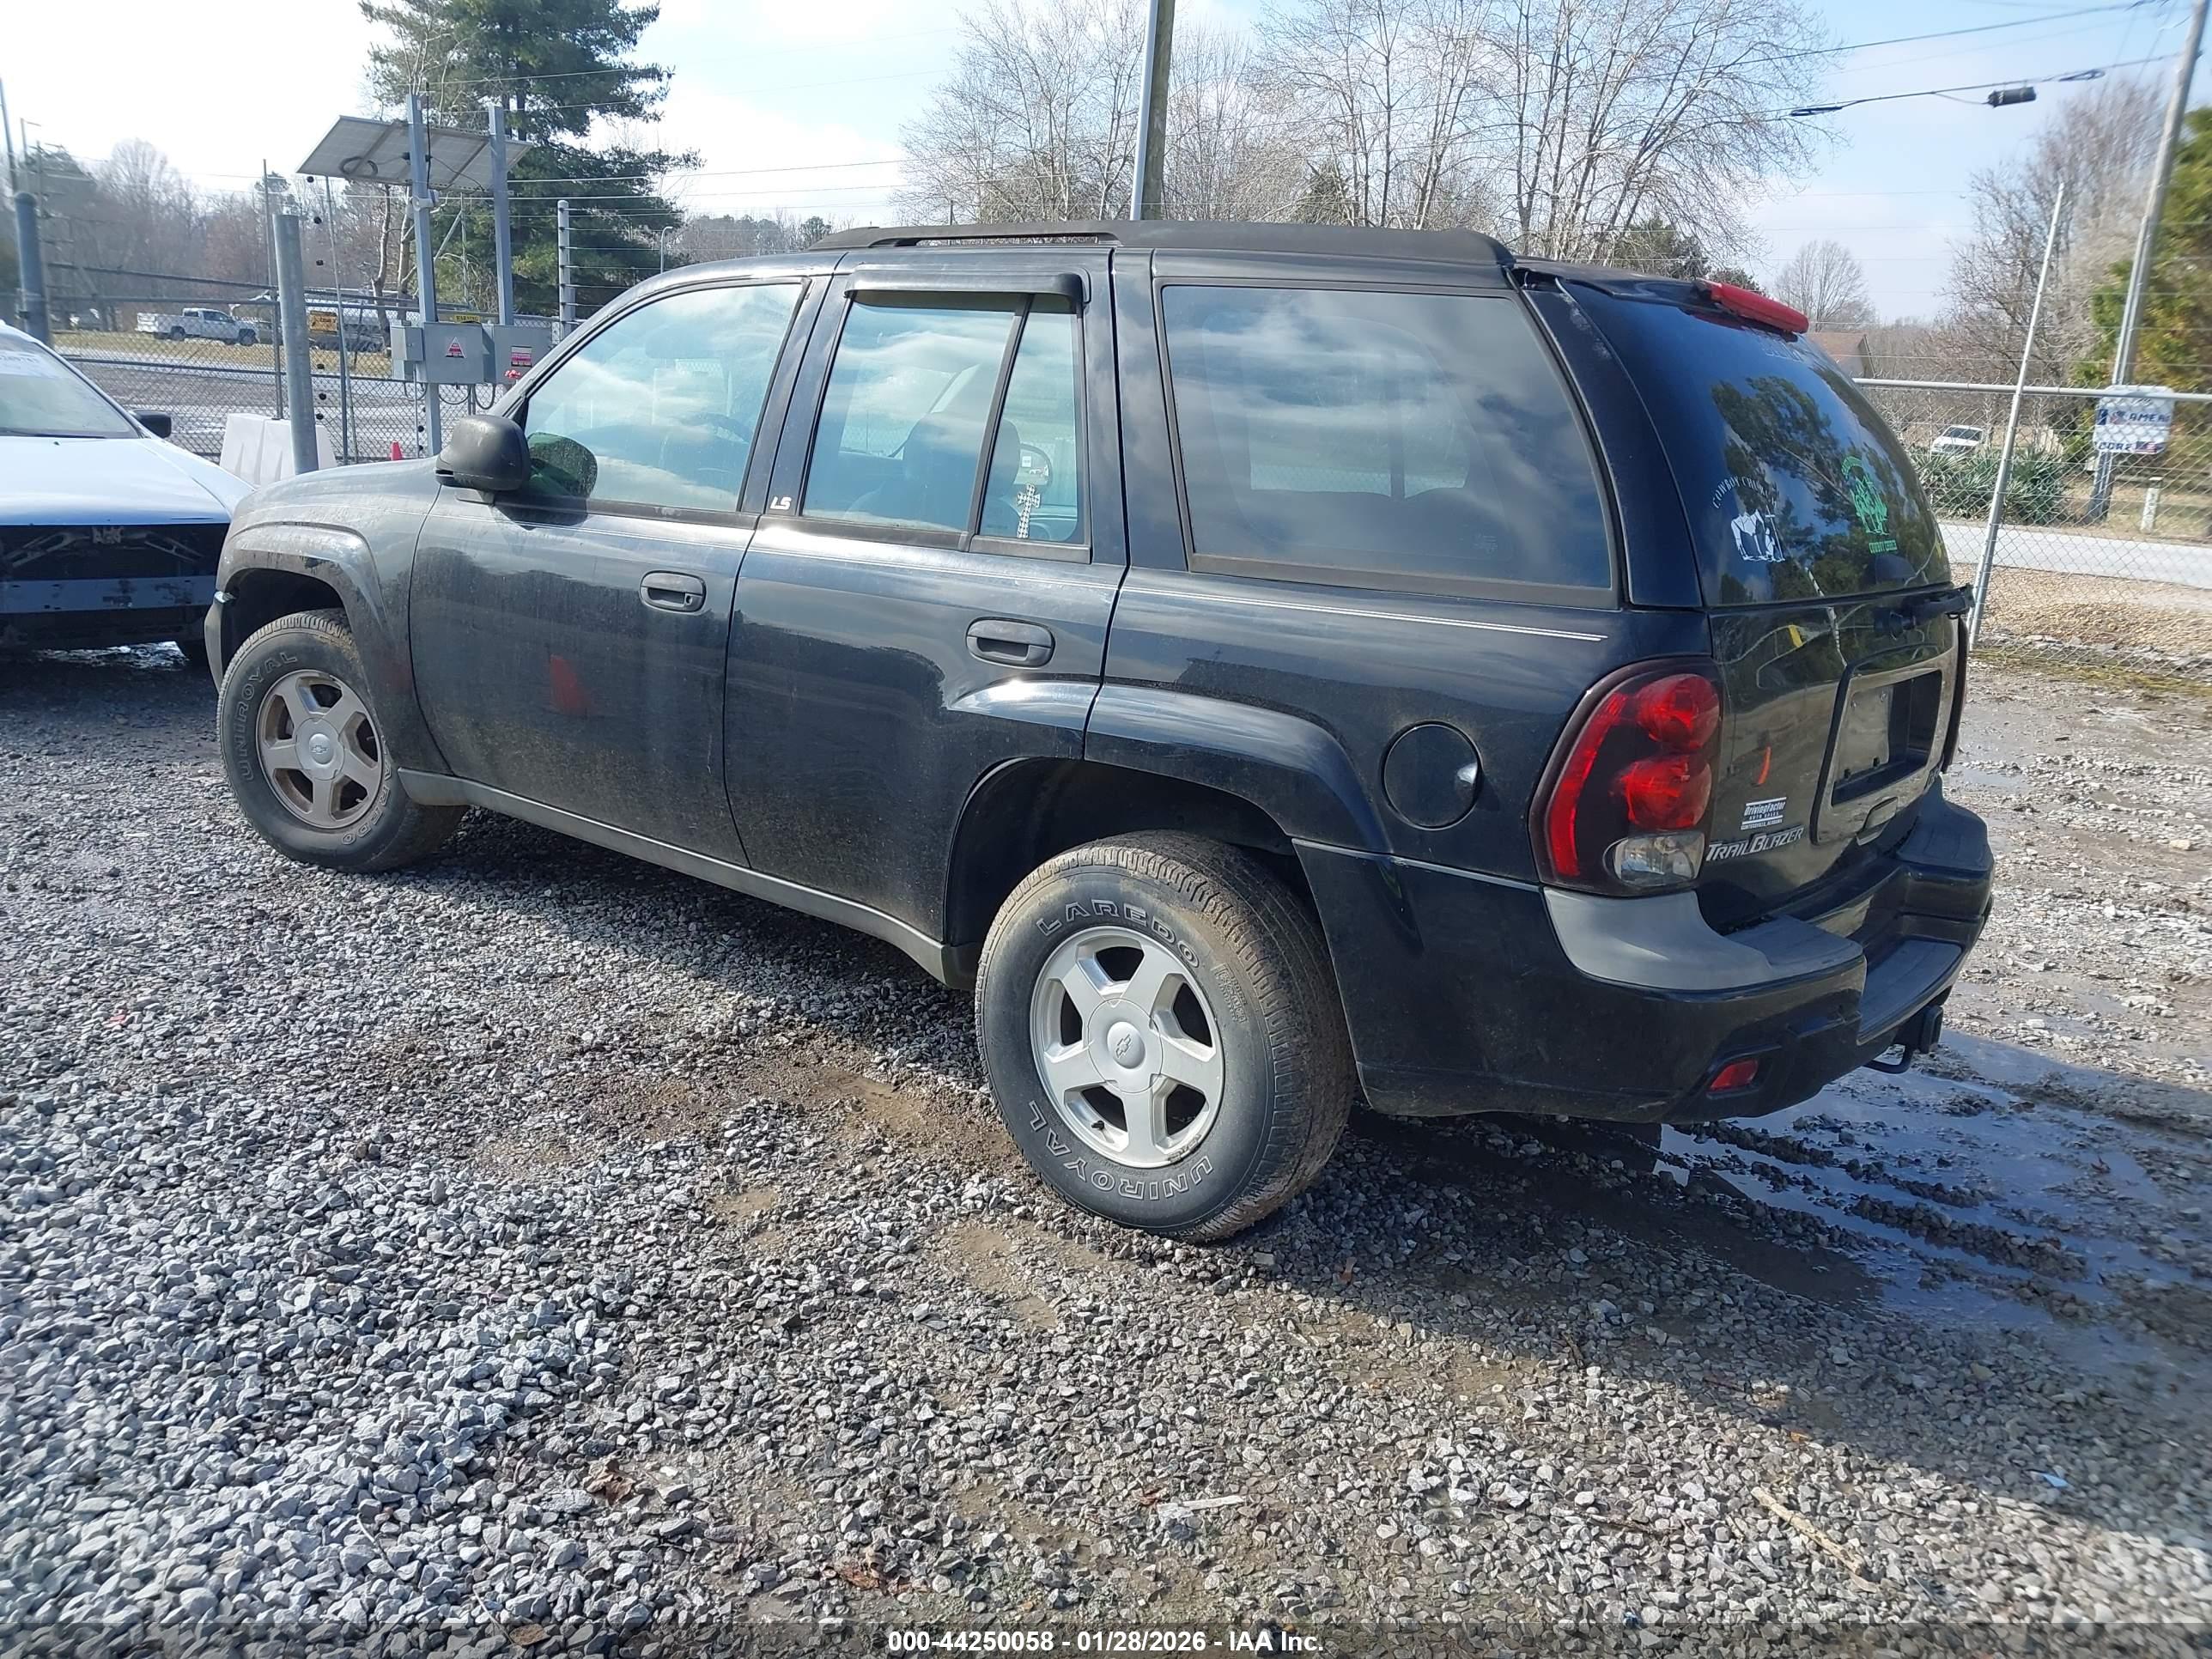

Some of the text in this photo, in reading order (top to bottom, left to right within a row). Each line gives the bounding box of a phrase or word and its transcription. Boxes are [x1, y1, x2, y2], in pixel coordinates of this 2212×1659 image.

[769, 495, 792, 511] LS
[233, 652, 298, 783] UNIROYAL
[1036, 898, 1200, 969] LAREDO
[1029, 1099, 1214, 1200] UNIROYAL
